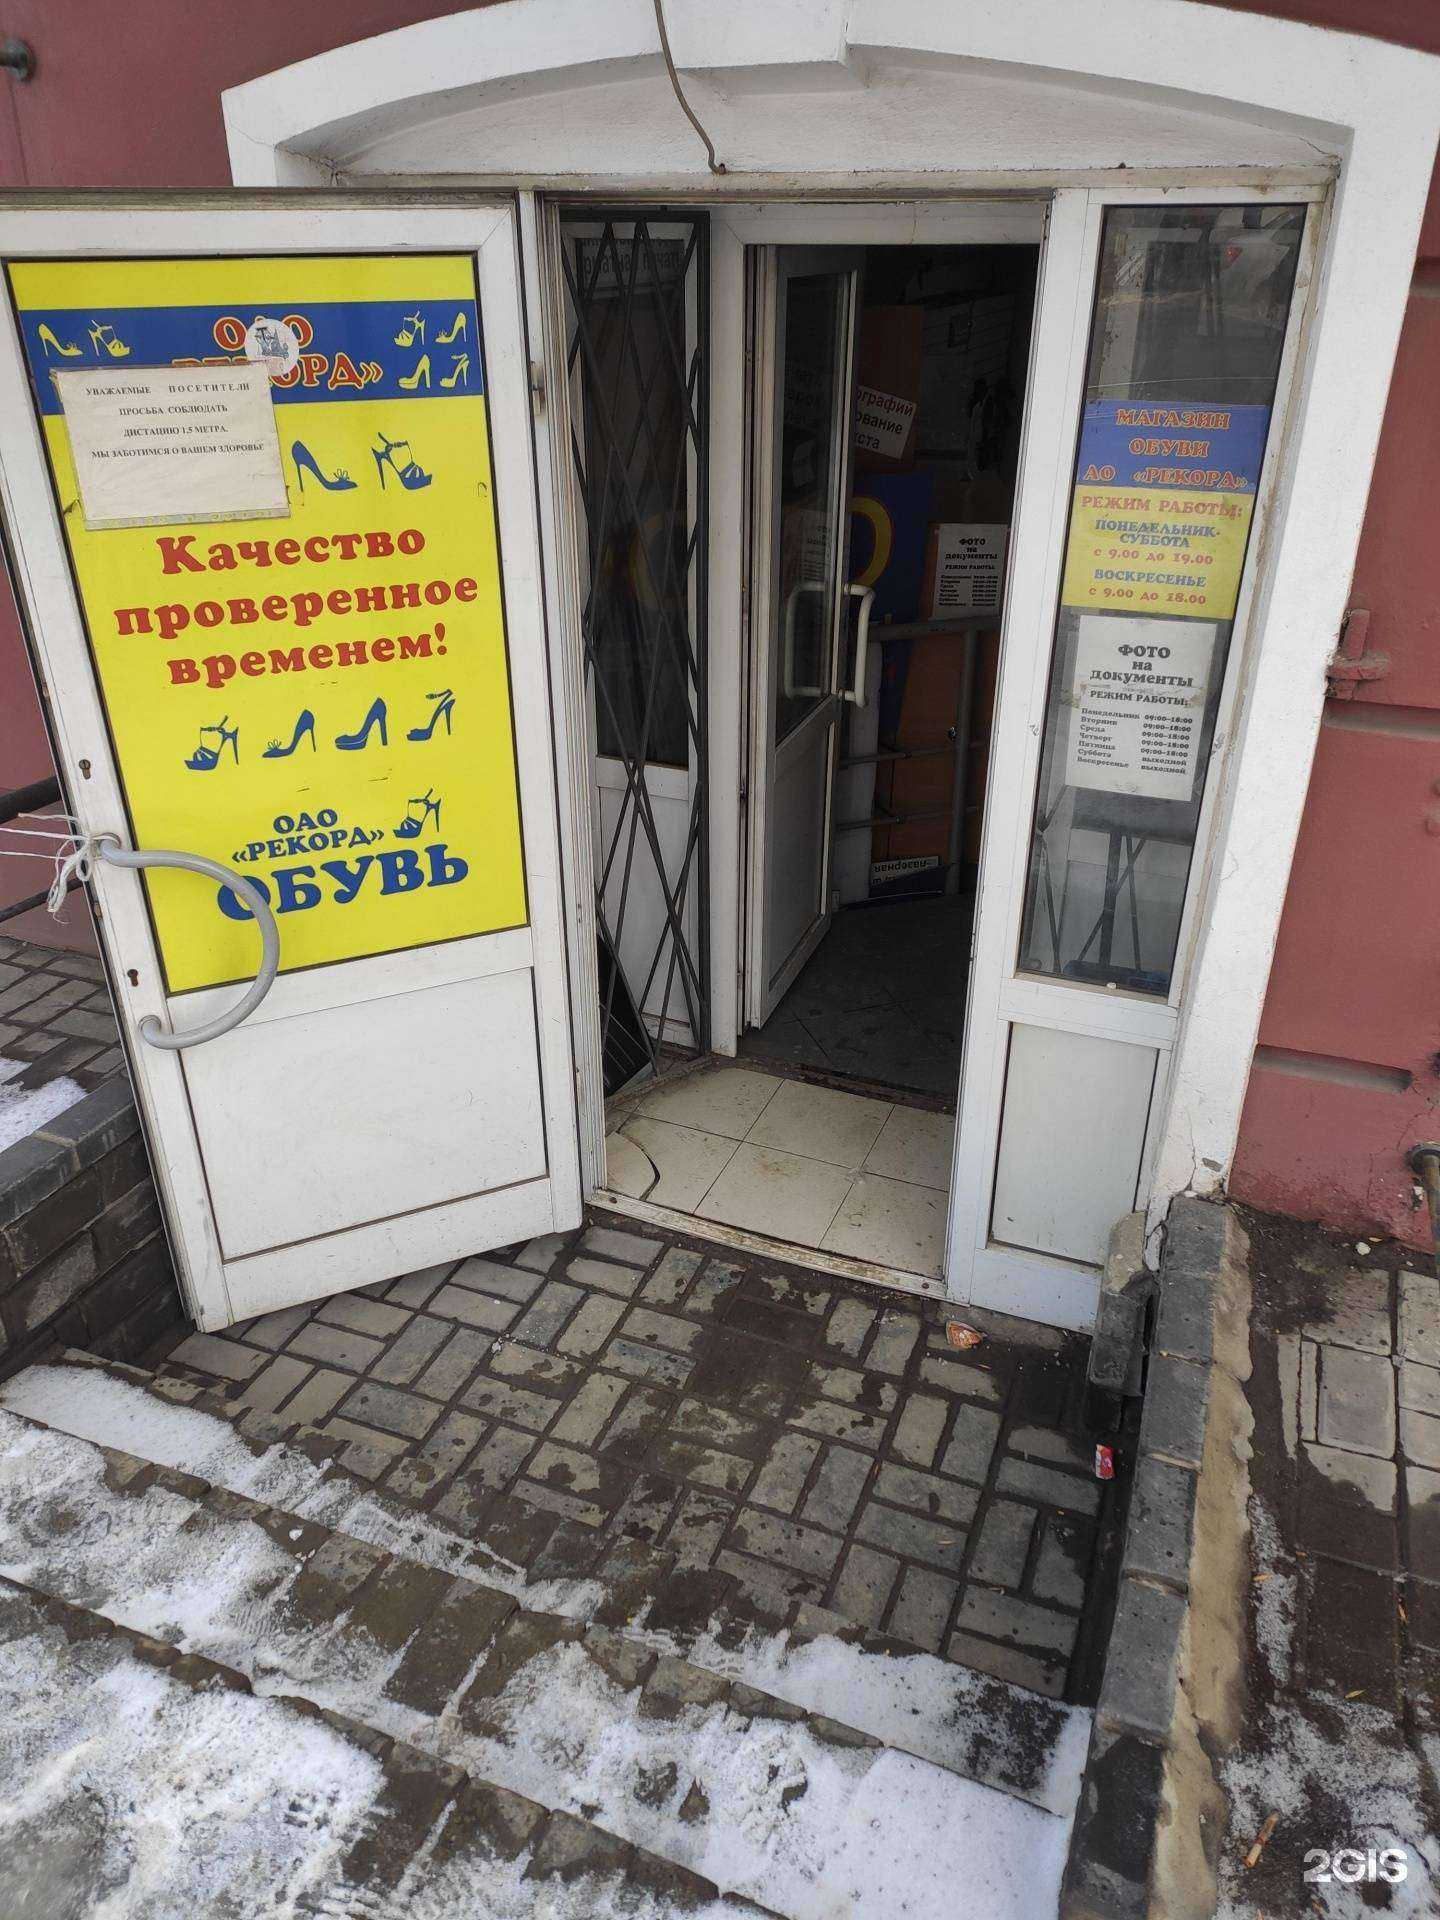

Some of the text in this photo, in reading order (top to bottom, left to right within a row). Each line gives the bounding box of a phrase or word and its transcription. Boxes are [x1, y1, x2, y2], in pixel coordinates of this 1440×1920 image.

[213, 315, 313, 351] ОО
[85, 383, 250, 396] УВАЖАЕМЫЕ ПОСЕТИТЕЛИ
[119, 404, 228, 416] ПРОСЬБА СОБЛЮДАТЬ
[1115, 408, 1231, 429] МАГАЗИН
[91, 450, 109, 459] МЫ
[112, 447, 170, 458] ЗАБОТИМСЯ
[181, 445, 217, 454] ВАШЕМ
[218, 443, 264, 453] ЗДОРОВЬЕ
[1128, 438, 1210, 457] ОБУВИ
[1083, 465, 1116, 481] АО
[1080, 495, 1243, 519] РЕЖИМ РАБОТЫ:
[1119, 533, 1191, 548] СУББОТА
[156, 529, 426, 575] Качество
[1108, 548, 1139, 559] 9.00
[1172, 552, 1213, 565] 19.00
[1094, 568, 1207, 587] ВОСКРЕСЕНЬЕ
[1103, 588, 1134, 599] 9.00
[1165, 592, 1206, 605] 18.00
[114, 577, 478, 639] проверенное
[167, 623, 448, 688] временем!
[1118, 644, 1171, 659] ФОТО
[1132, 661, 1153, 671] на
[1090, 670, 1194, 687] документы
[1090, 690, 1188, 706] РЕЖИМ РАБОТЫ:
[1079, 732, 1113, 742] Четверг
[1080, 724, 1106, 734] Среда
[1078, 749, 1112, 759] Суббота
[273, 808, 338, 834] ОАО
[231, 826, 385, 862] «РЕКОРД»
[217, 844, 469, 921] ОБУВЬ
